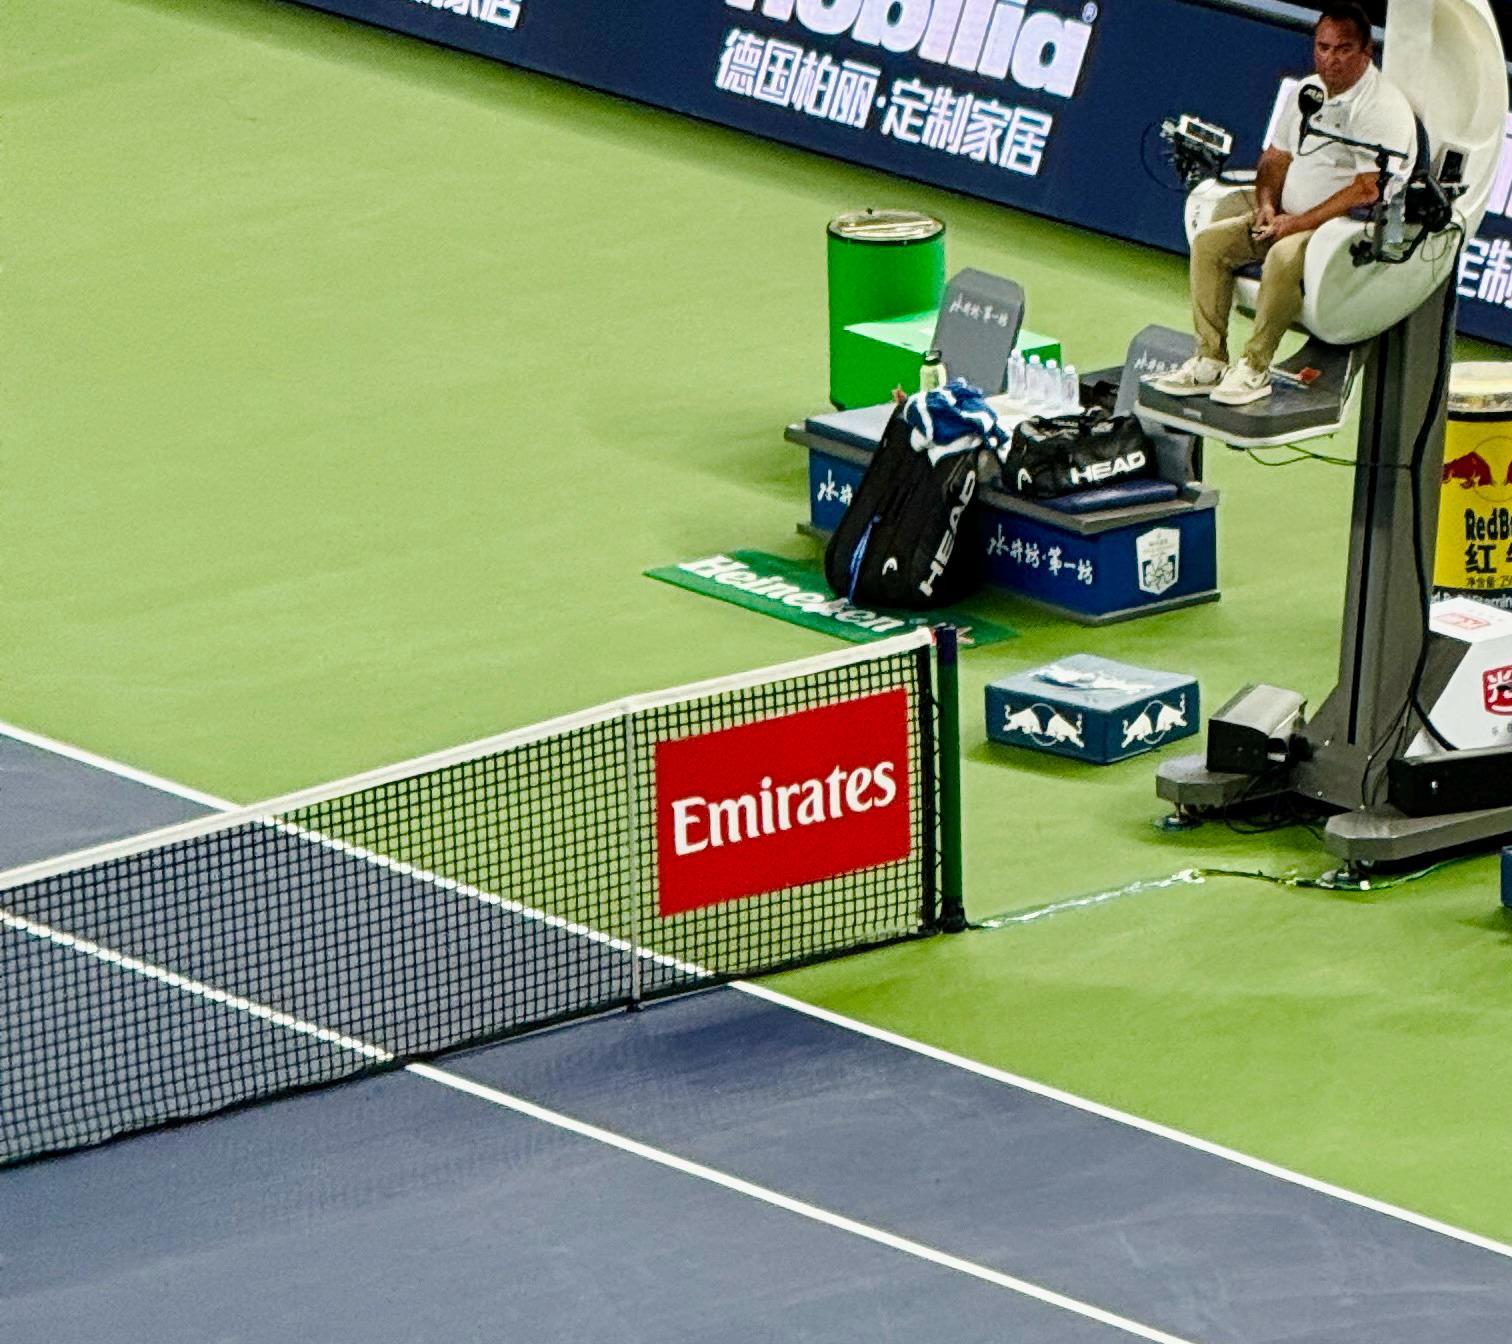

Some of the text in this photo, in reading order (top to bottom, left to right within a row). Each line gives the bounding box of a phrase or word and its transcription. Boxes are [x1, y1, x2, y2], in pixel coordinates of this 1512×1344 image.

[715, 28, 1054, 176] 德国柏丽·定制家居
[1070, 450, 1146, 485] HEAD
[919, 469, 977, 597] HEAD
[678, 554, 905, 632] Heineken
[671, 761, 897, 857] Emirates
